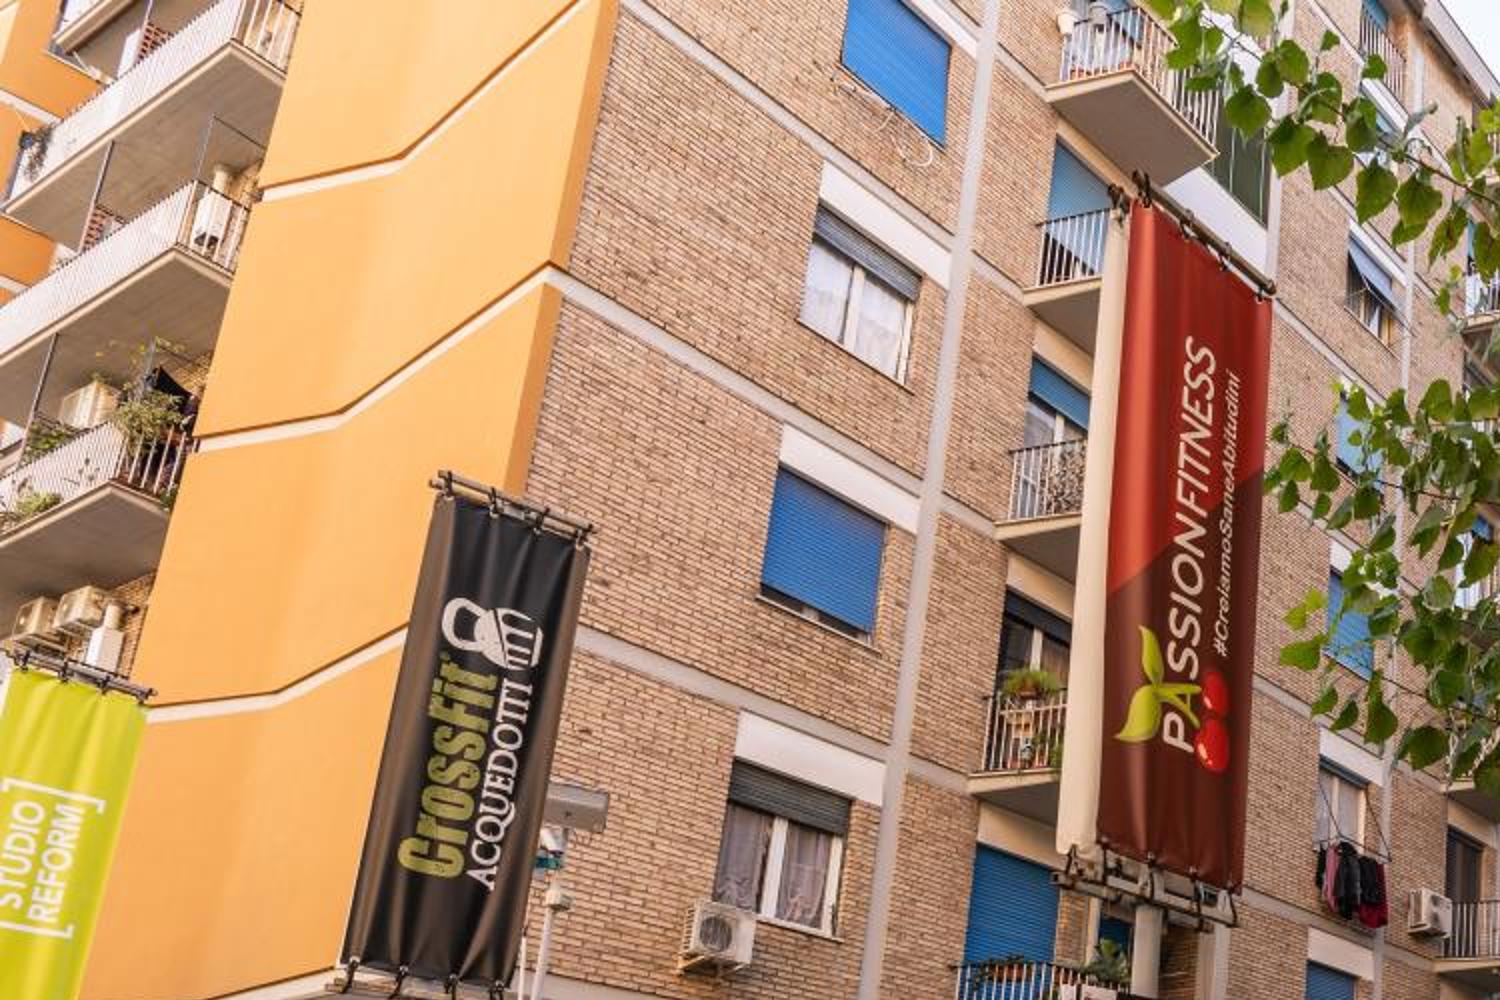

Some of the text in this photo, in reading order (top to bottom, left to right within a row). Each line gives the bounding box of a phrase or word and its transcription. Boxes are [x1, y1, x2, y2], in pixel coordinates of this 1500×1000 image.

[27, 803, 85, 923] REFORM
[397, 660, 499, 879] CrossFit
[465, 678, 534, 891] ACQUEDOTTI
